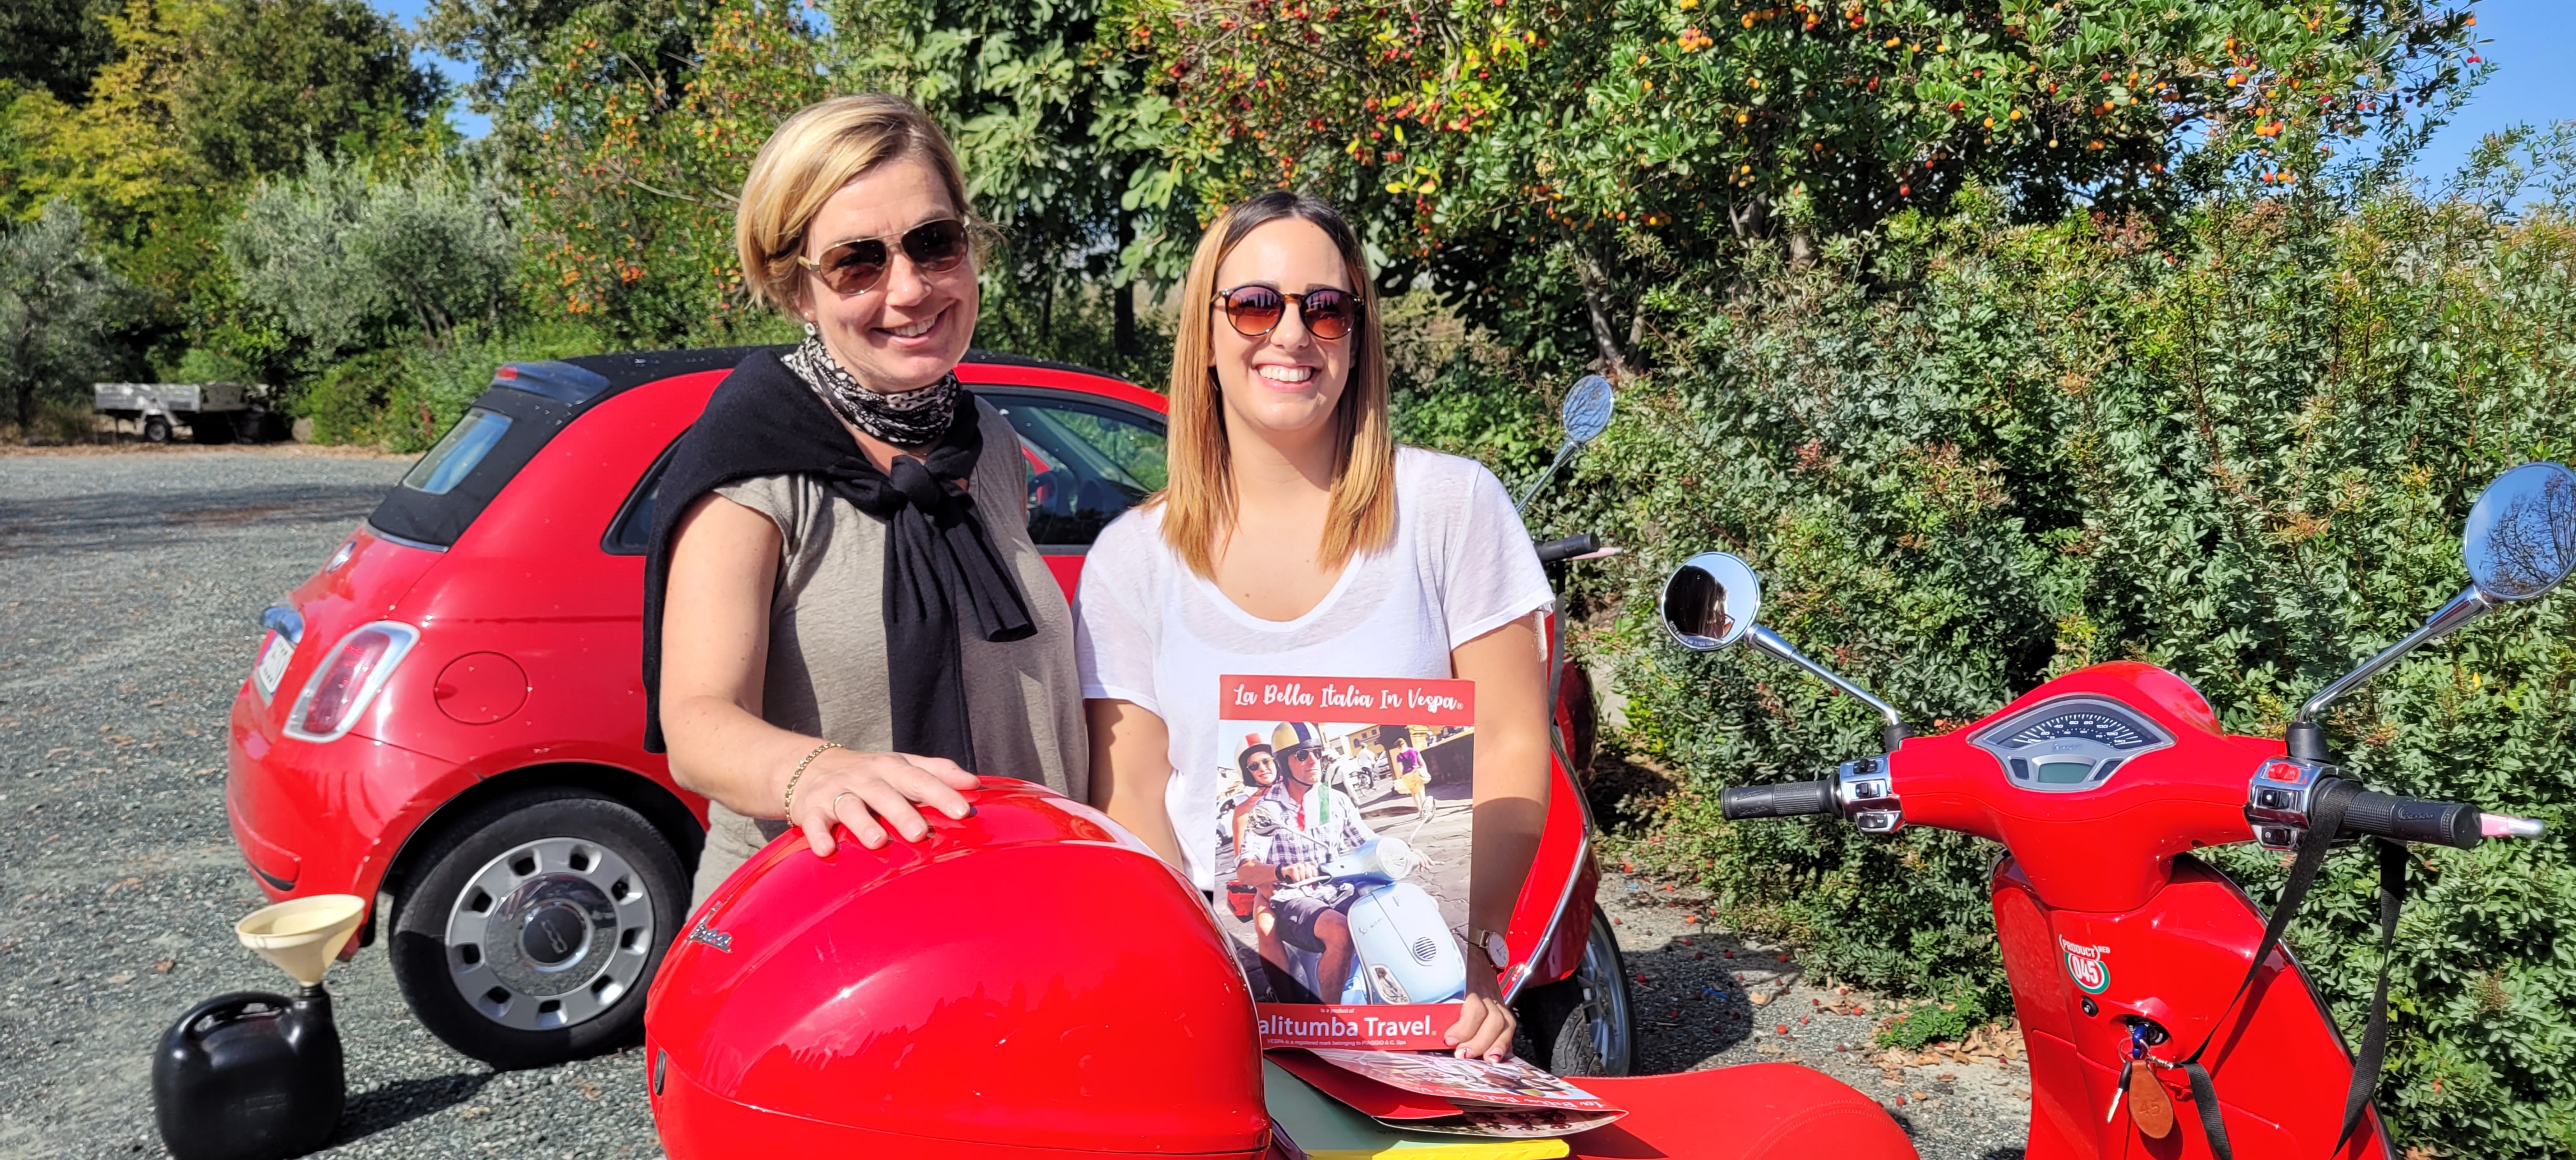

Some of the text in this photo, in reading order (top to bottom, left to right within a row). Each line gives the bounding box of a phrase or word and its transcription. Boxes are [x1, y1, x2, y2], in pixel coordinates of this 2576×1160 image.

[1233, 683, 1258, 706] La
[1262, 683, 1315, 706] Bella
[1319, 683, 1374, 708] Italia
[1379, 689, 1403, 710] In
[2072, 956, 2099, 984] 045
[1260, 1015, 1358, 1036] alitumba
[2138, 1098, 2160, 1117] 45
